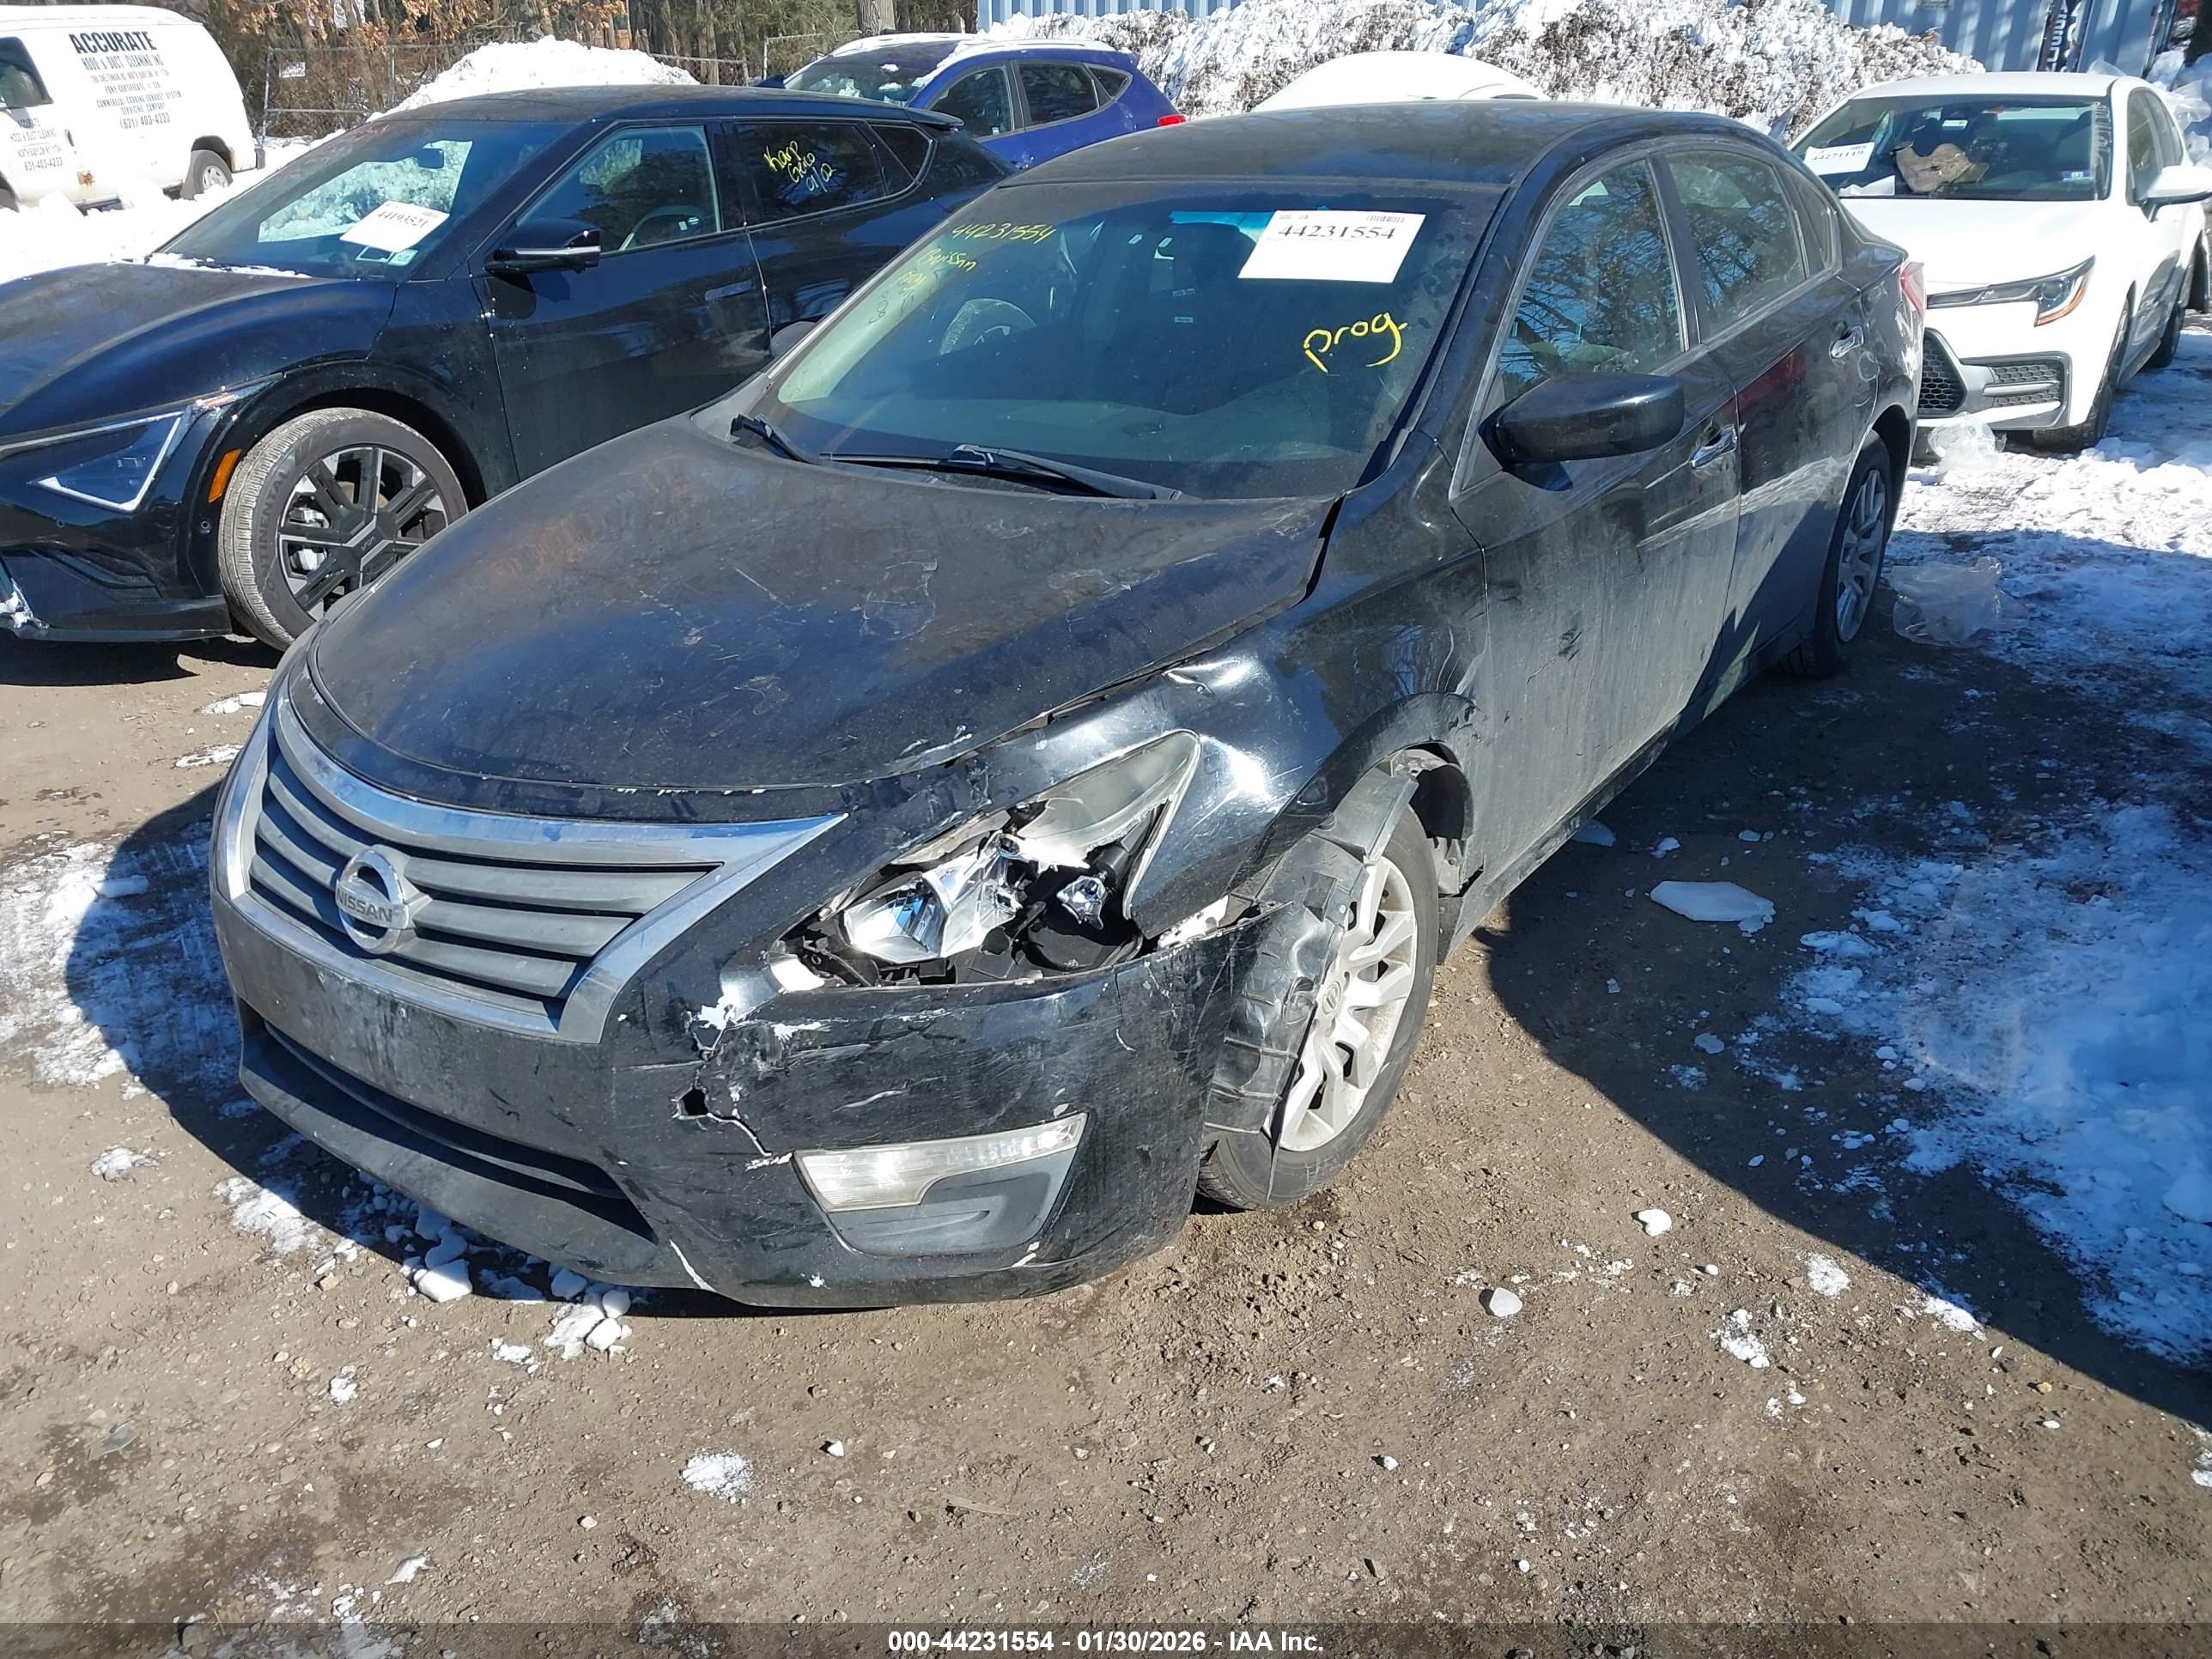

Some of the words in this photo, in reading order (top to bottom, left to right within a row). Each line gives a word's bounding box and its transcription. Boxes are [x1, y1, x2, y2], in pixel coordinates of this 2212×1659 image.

[69, 31, 158, 54] ACCURATE
[81, 57, 100, 70] HOOD
[119, 117, 138, 130] (631)
[140, 112, 172, 126] 403-4233
[951, 222, 1057, 245] 44231554
[1278, 224, 1397, 240] 44231554
[336, 888, 393, 923] NISSAN
